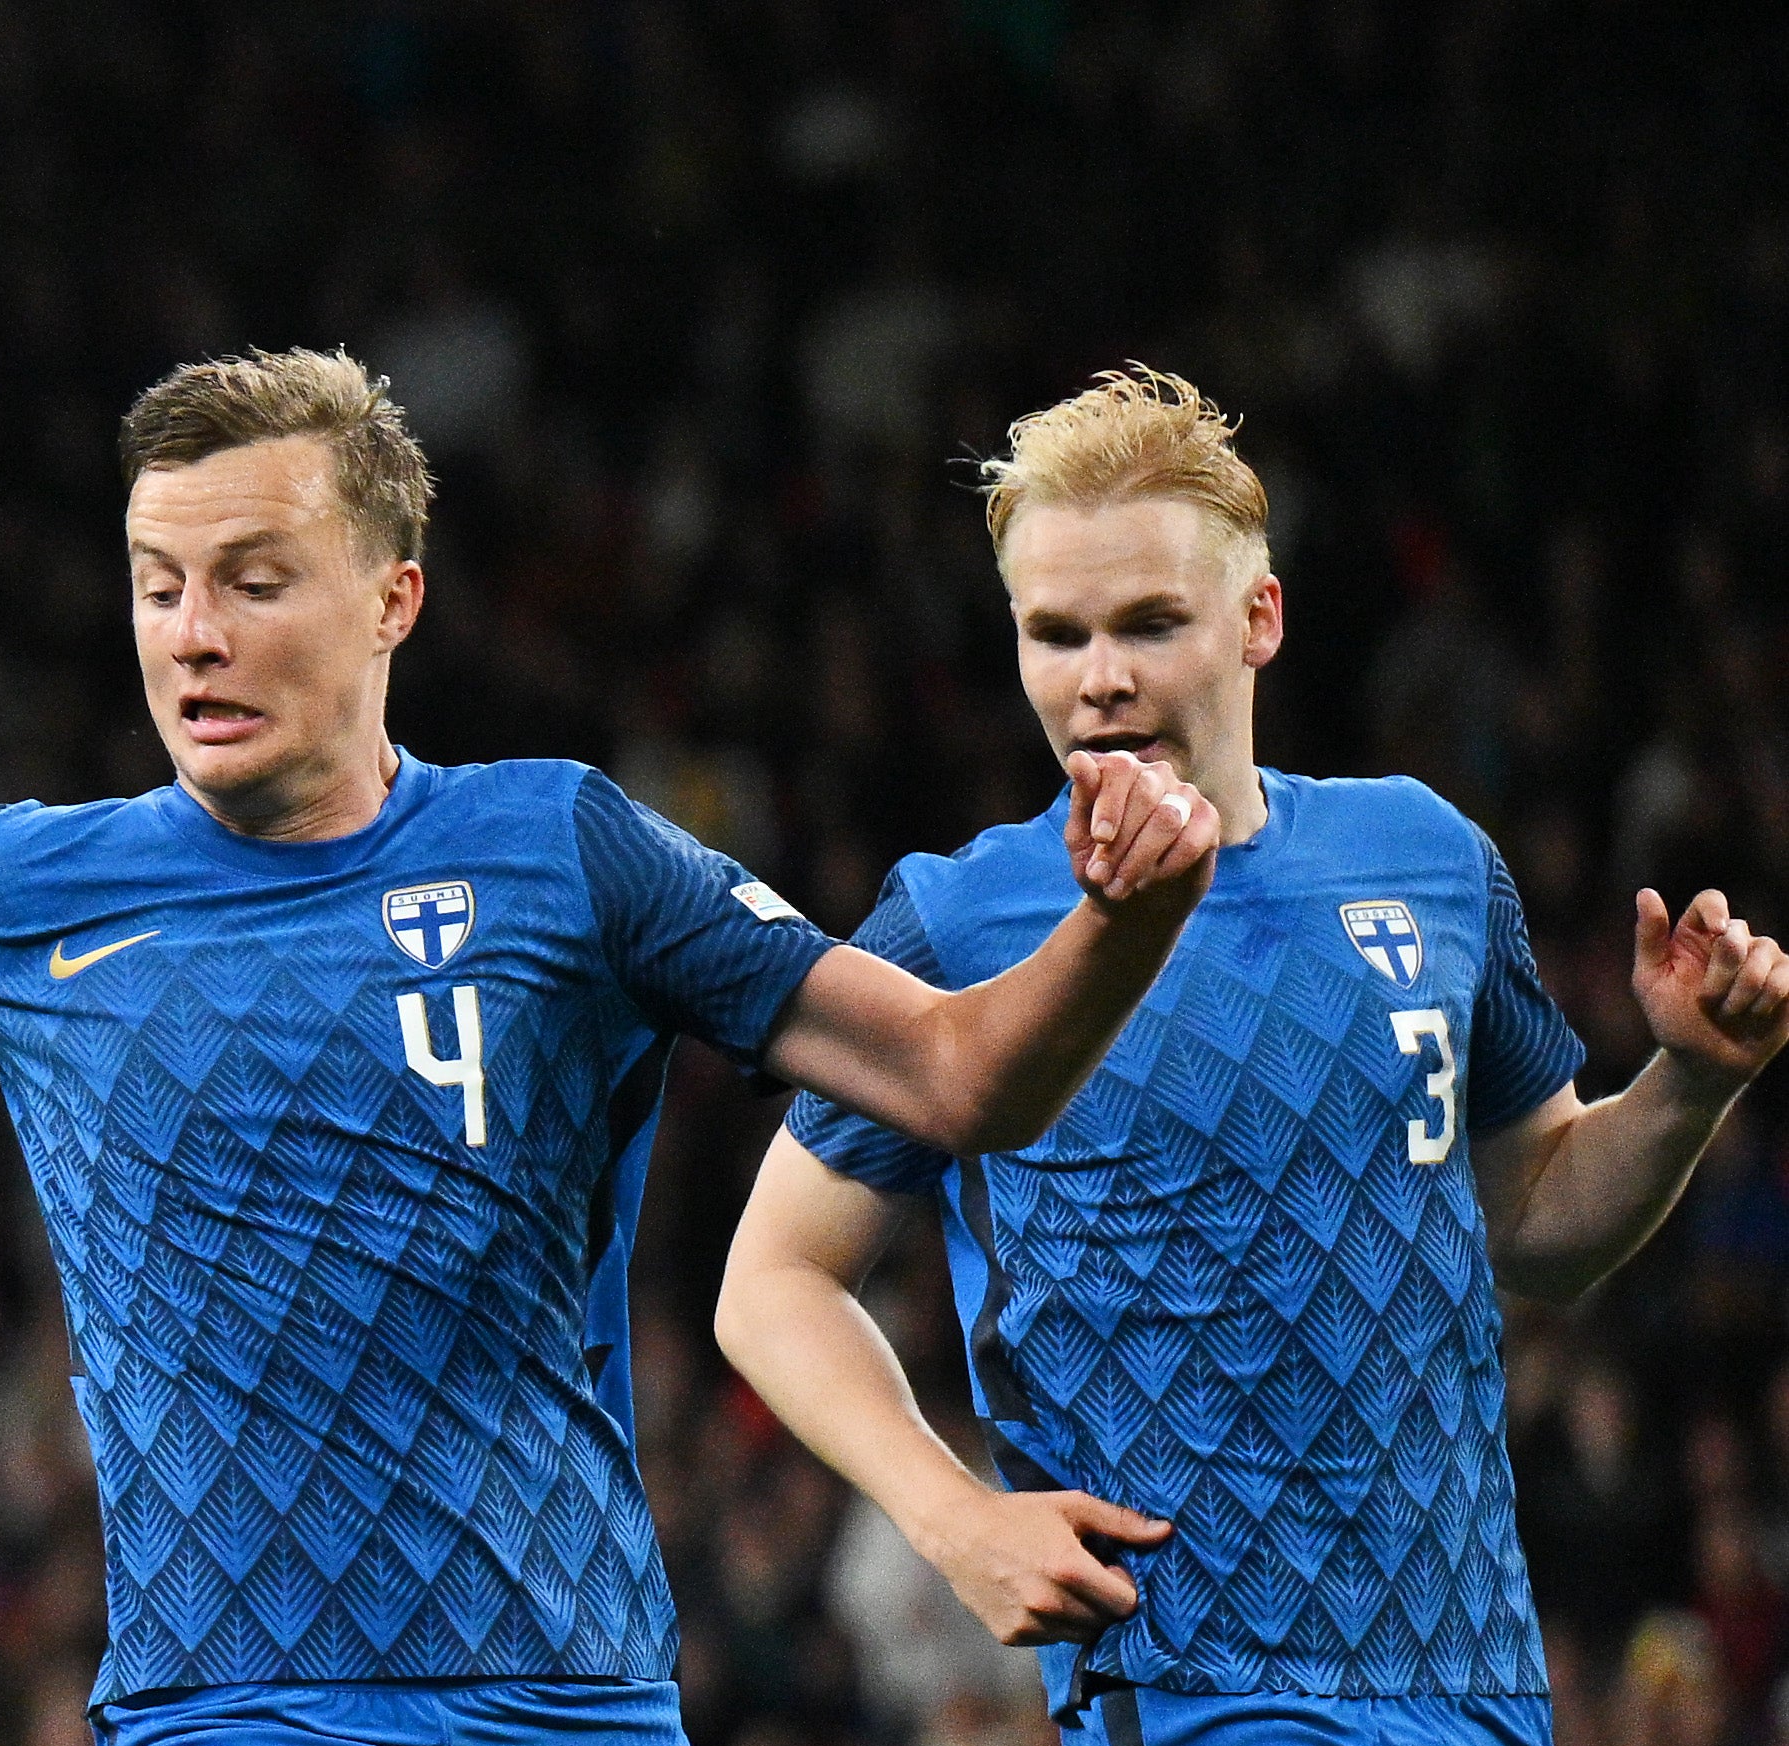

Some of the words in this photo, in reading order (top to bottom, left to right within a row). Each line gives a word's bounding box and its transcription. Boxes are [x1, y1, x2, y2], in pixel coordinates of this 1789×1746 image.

[398, 890, 455, 904] SUOMI
[396, 985, 487, 1147] 4
[1389, 1009, 1455, 1165] 3
